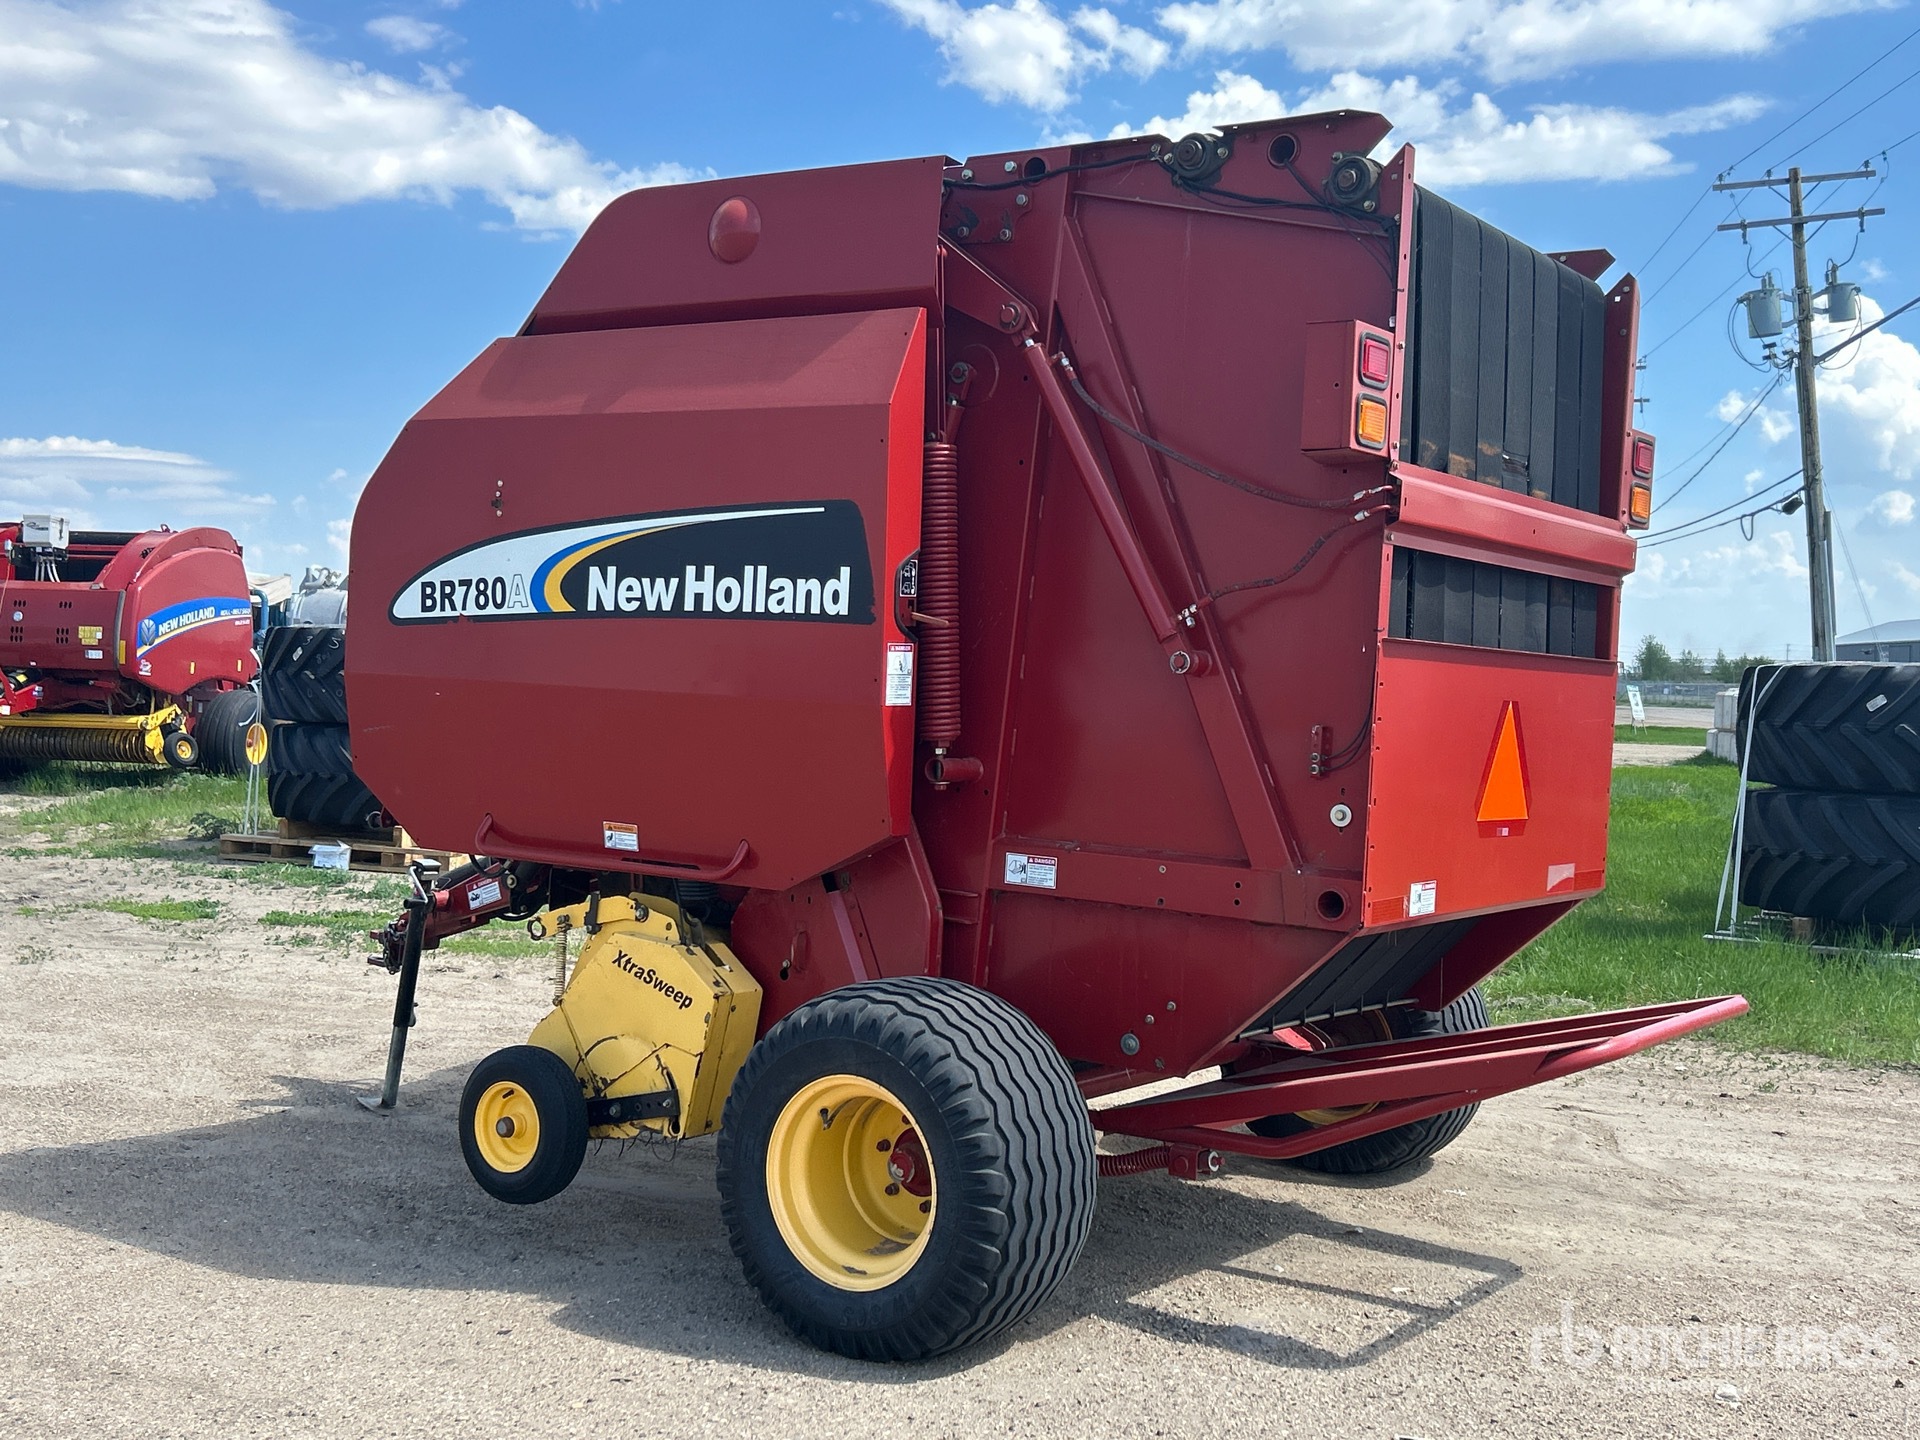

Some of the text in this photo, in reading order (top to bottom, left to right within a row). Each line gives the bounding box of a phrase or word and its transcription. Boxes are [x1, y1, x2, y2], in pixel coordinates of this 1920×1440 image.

[420, 574, 529, 613] BR780A
[587, 564, 851, 616] New Holland
[158, 606, 216, 636] NEW HOLLAND
[611, 949, 693, 1010] XtraSweep
